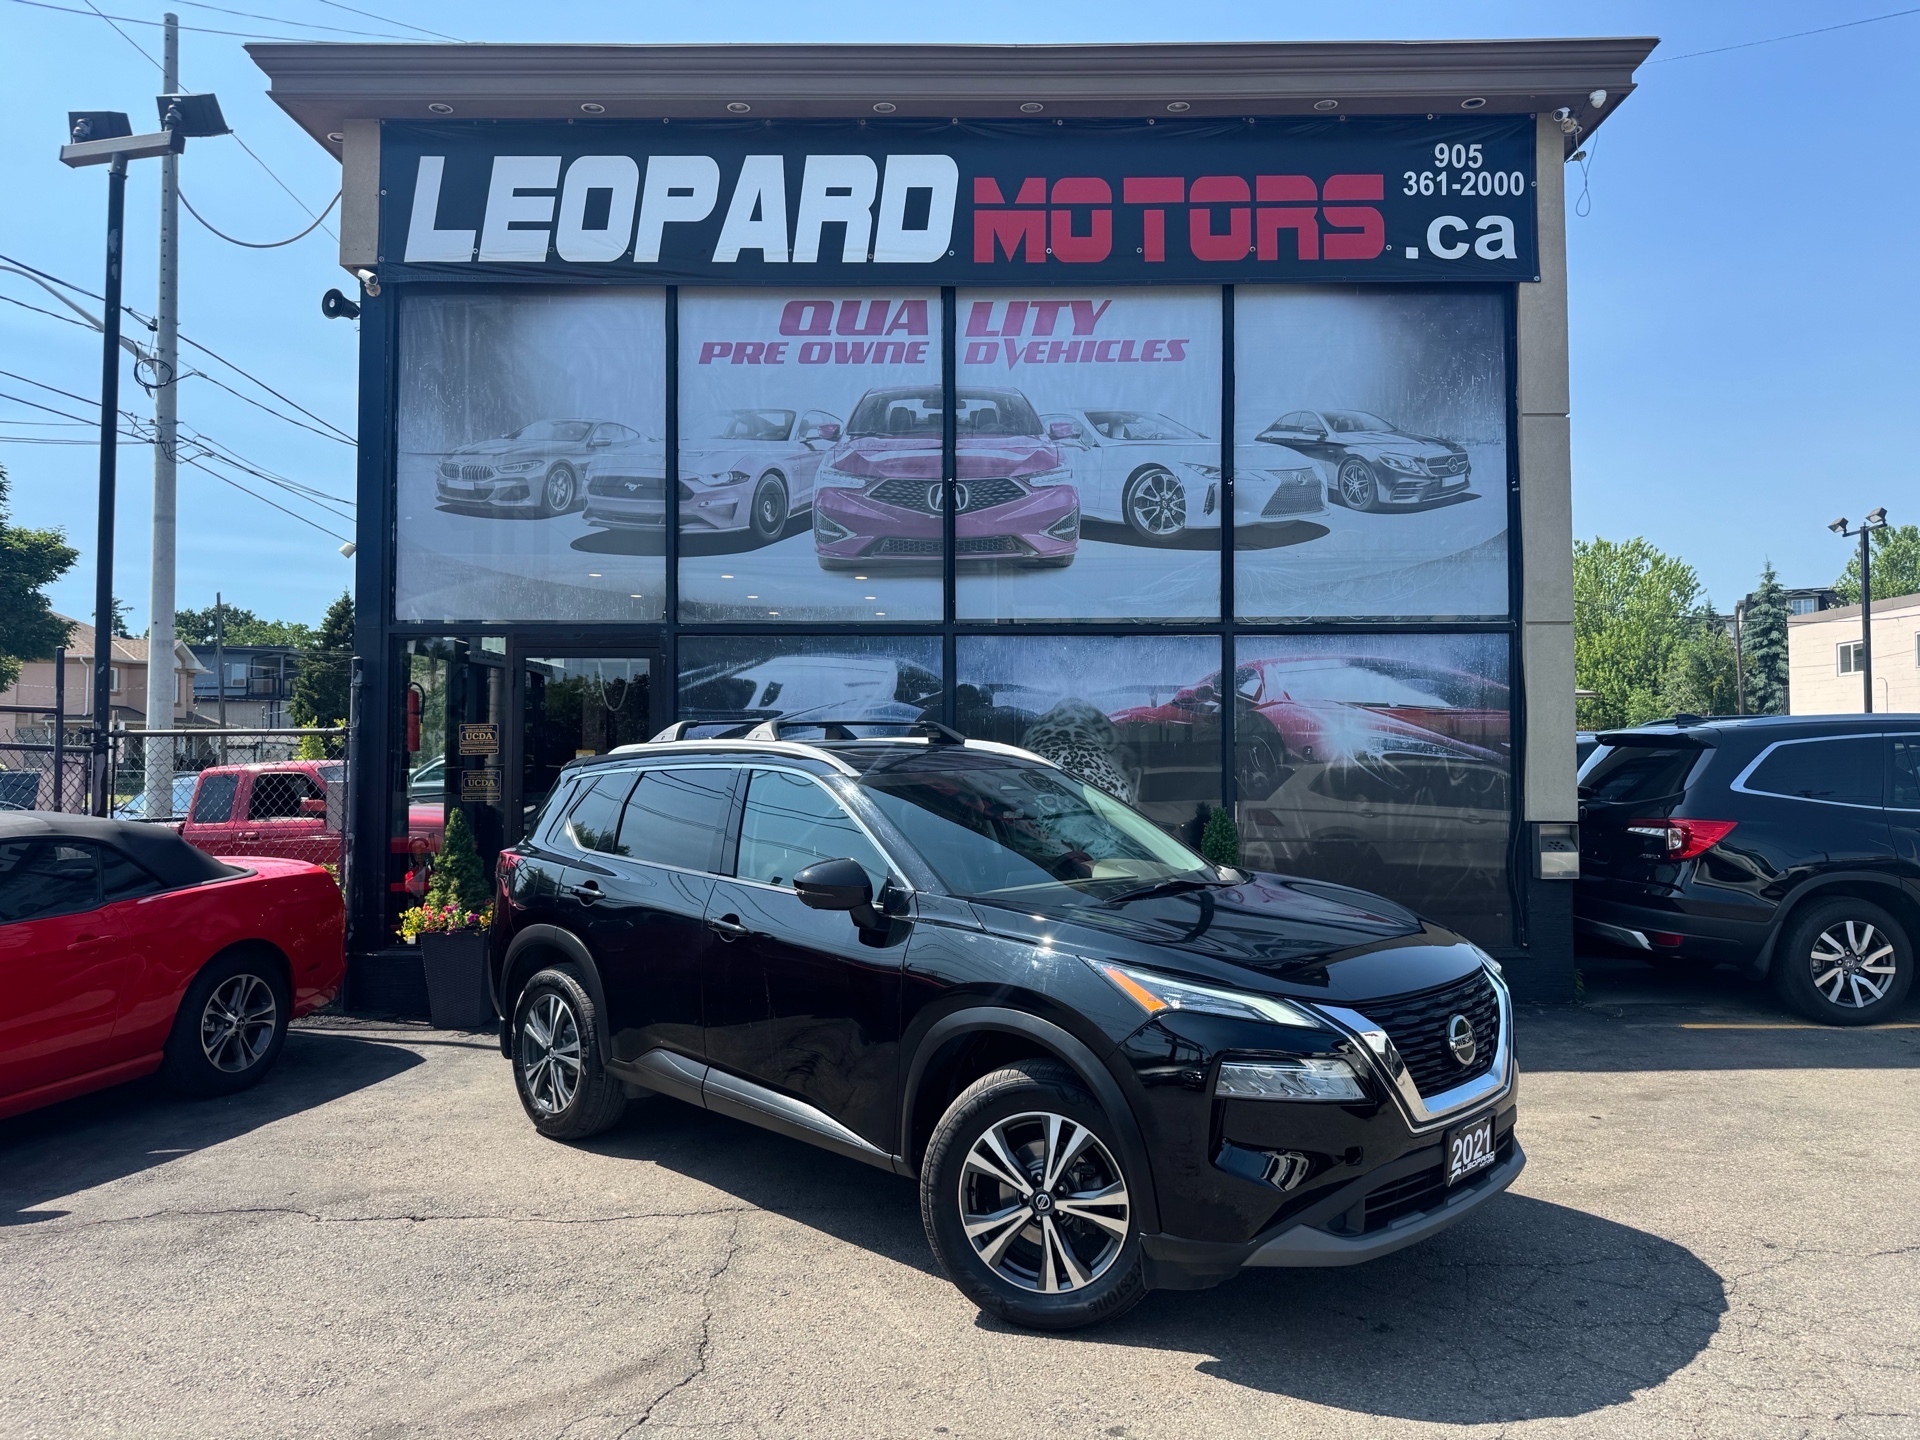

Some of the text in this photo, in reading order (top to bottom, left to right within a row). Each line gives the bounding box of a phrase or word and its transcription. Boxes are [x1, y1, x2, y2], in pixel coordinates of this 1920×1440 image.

[1434, 143, 1483, 169] 905
[1403, 171, 1525, 196] 361-2000
[404, 154, 1385, 263] LEOPARD MOTORS
[1405, 214, 1518, 260] .ca
[779, 300, 1112, 337] QUA LITY
[698, 341, 789, 364] PRE
[798, 341, 930, 364] OWNE
[465, 732, 493, 740] UCDA
[468, 779, 495, 787] UCDA
[1451, 1123, 1490, 1171] 2021
[1462, 1150, 1495, 1172] LEOPARD
